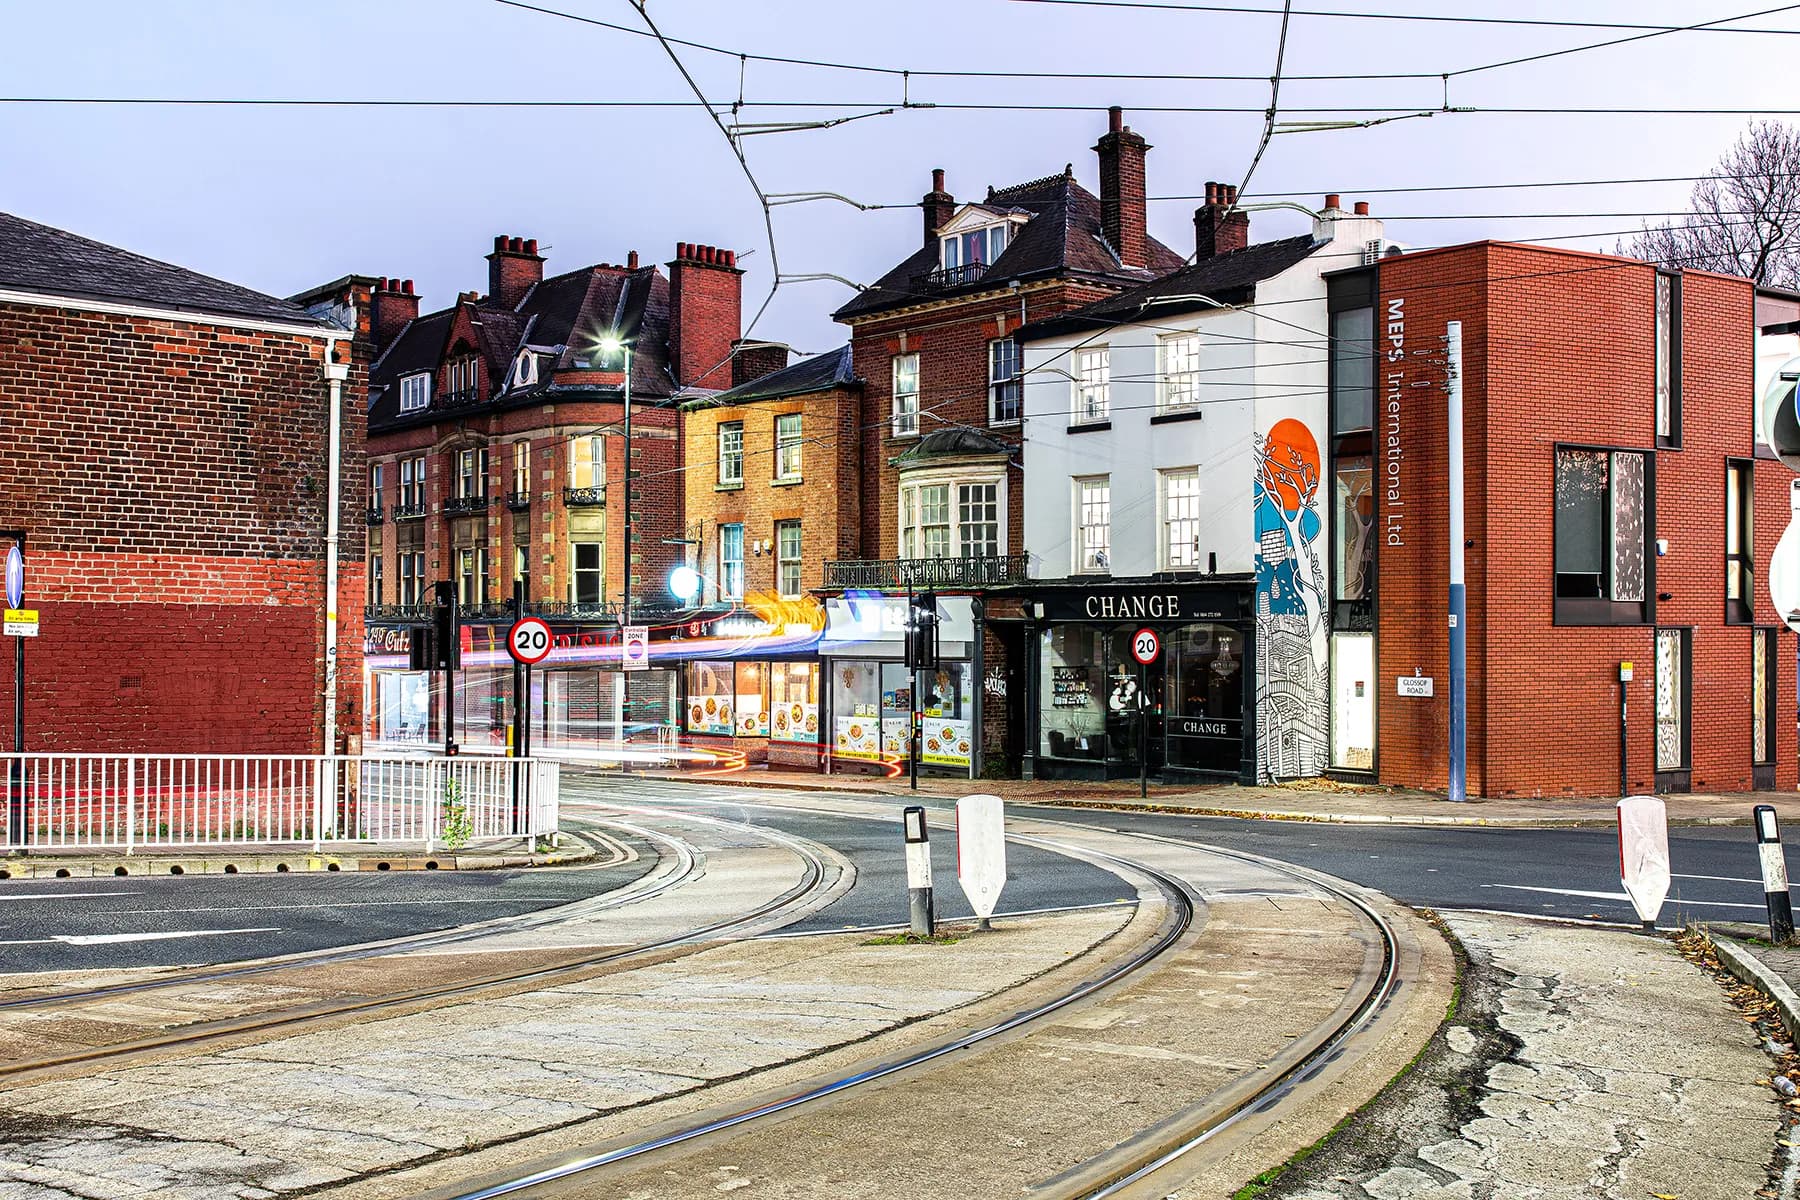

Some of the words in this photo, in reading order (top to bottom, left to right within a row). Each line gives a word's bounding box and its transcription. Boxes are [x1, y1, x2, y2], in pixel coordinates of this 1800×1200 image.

[1388, 298, 1404, 362] MEPS
[1388, 371, 1404, 505] International
[1388, 514, 1404, 546] Ltd
[1086, 595, 1180, 618] CHANGE
[385, 629, 410, 652] Cutz
[517, 631, 547, 649] 20
[1137, 639, 1155, 654] 20
[1183, 721, 1227, 734] CHANGE
